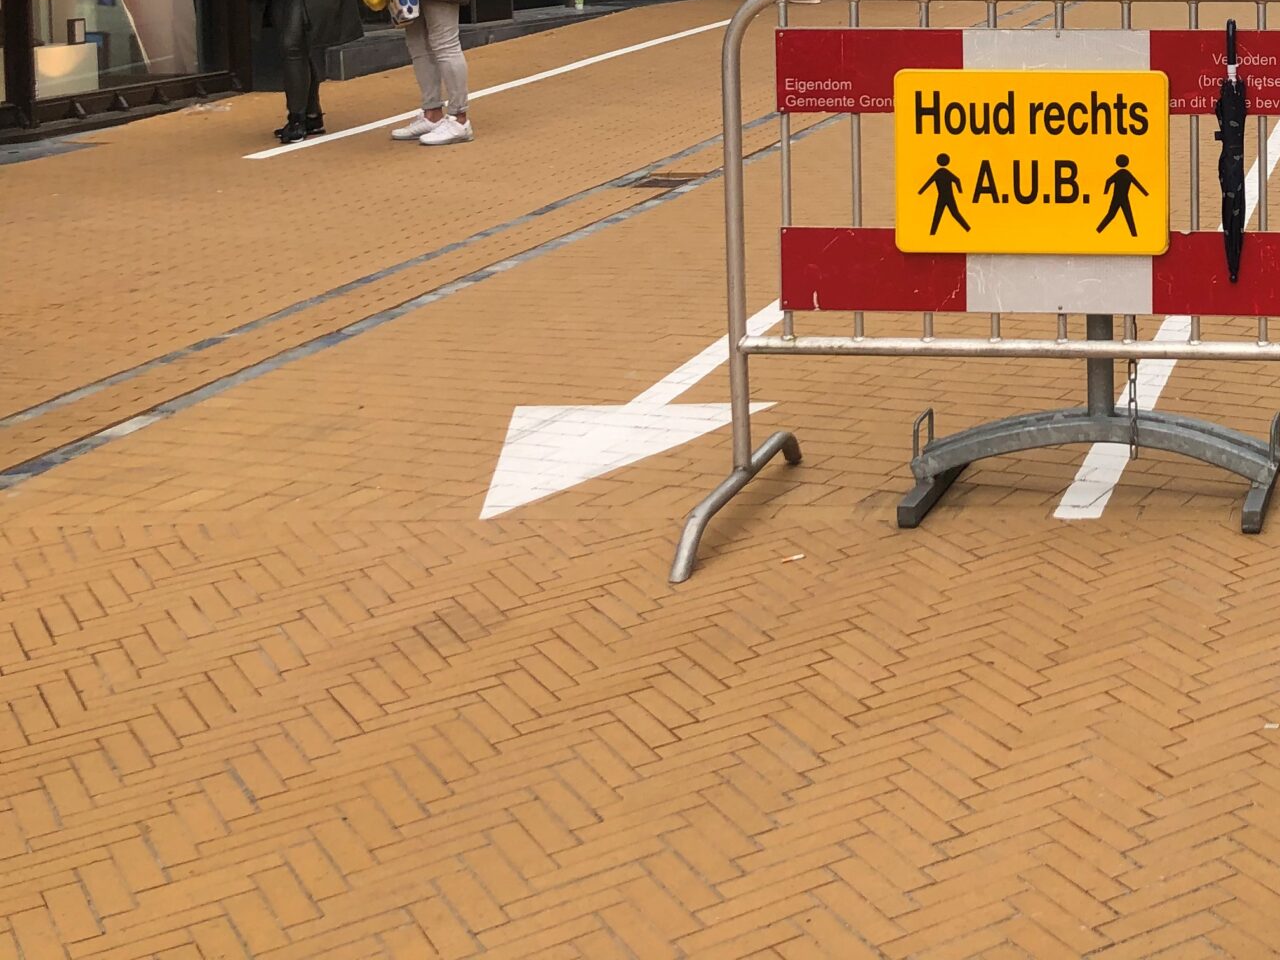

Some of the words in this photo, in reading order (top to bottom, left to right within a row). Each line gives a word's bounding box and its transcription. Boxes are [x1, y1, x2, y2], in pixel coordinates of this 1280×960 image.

[1212, 53, 1277, 66] Veboden
[785, 78, 852, 93] Eigendom
[785, 95, 855, 107] Gemeente
[860, 95, 894, 107] Gron
[1170, 98, 1185, 108] an
[1190, 96, 1206, 108] dit
[915, 91, 1015, 135] Houd
[1029, 91, 1149, 135] rechts
[972, 160, 1090, 204] A.U.B.
